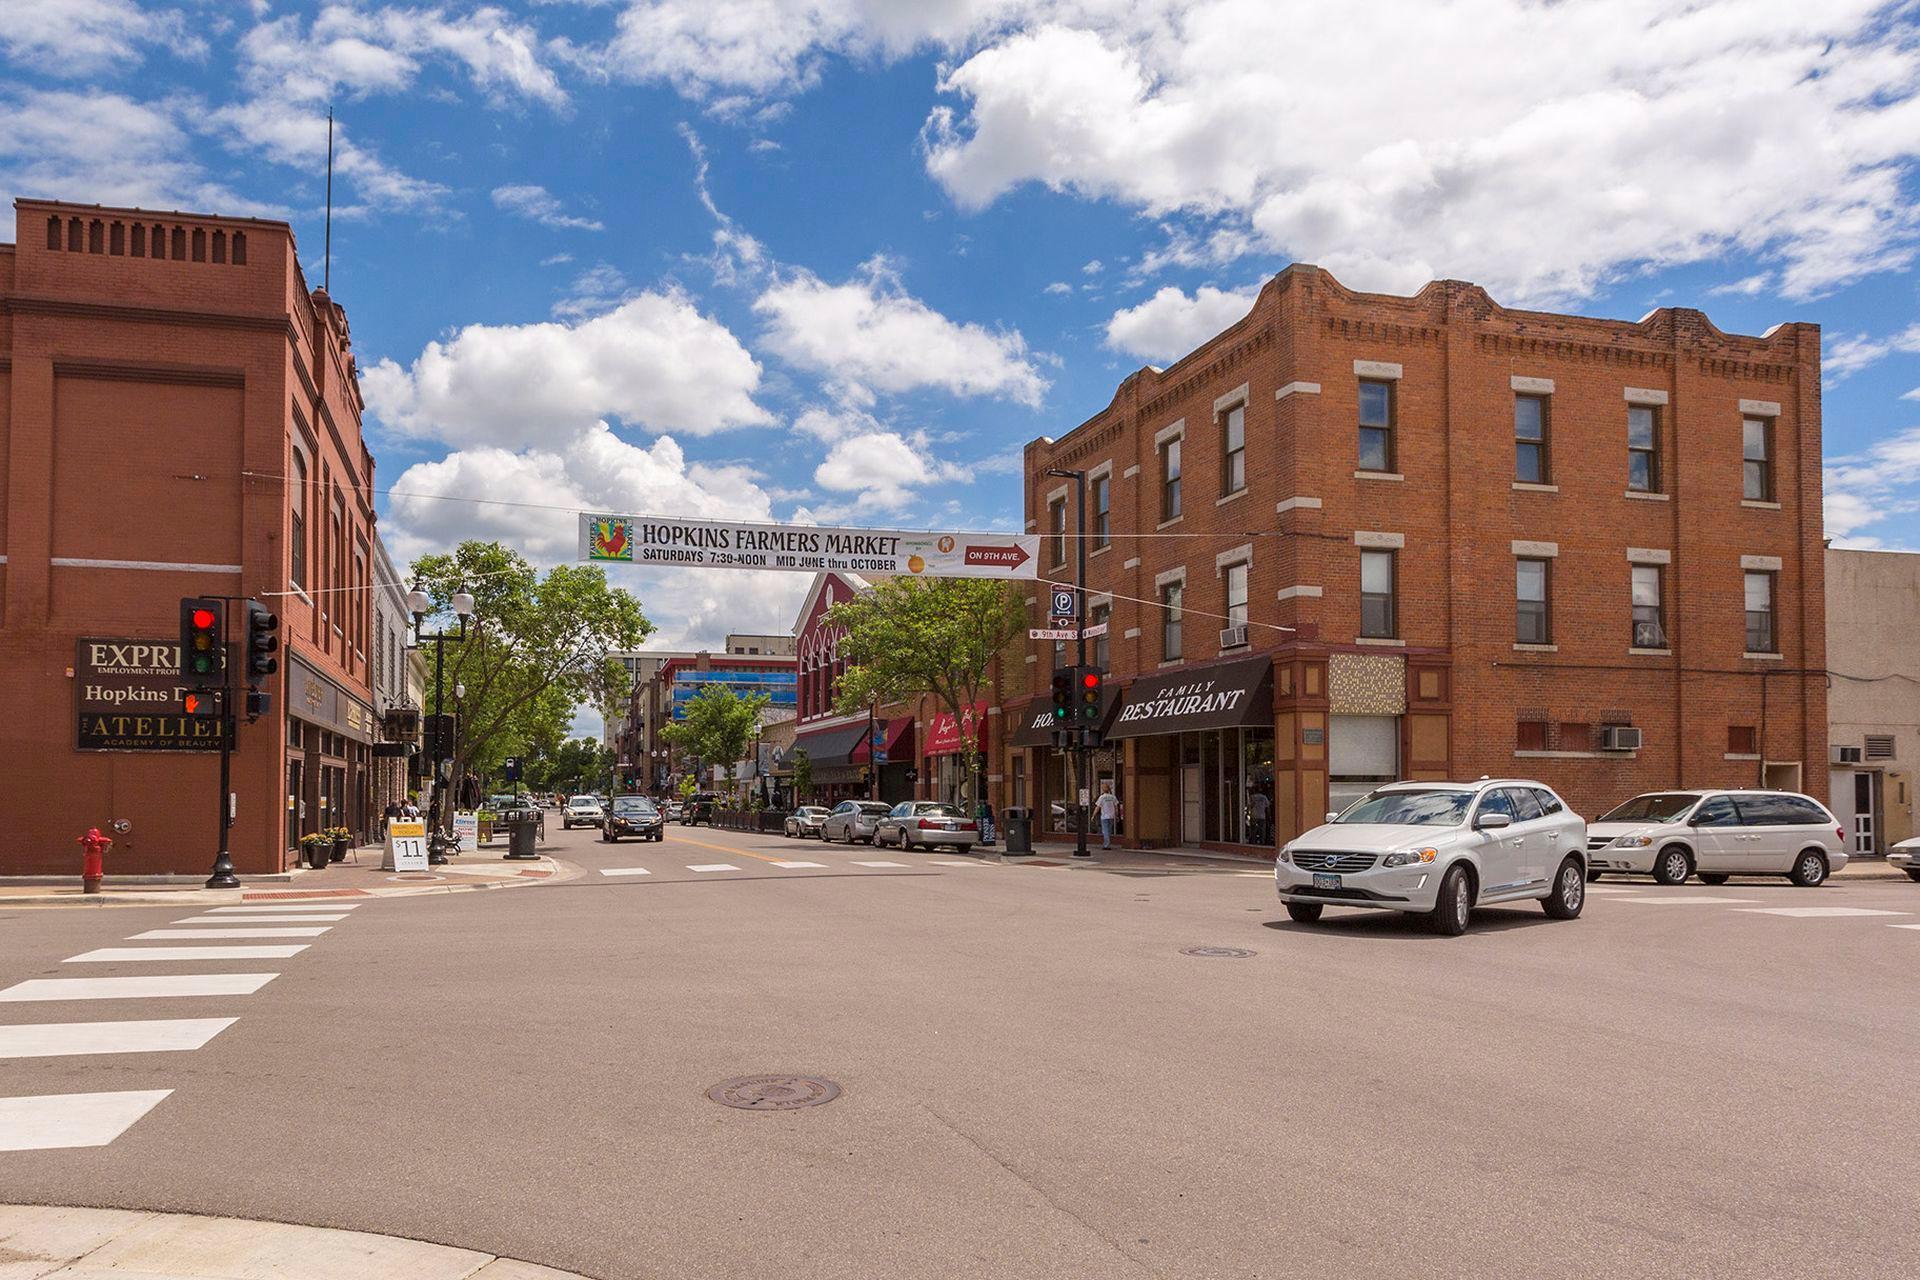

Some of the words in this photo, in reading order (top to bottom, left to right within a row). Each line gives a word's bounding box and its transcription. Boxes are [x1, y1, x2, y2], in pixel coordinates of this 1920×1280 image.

[643, 524, 729, 548] HOPKINS
[736, 530, 820, 553] FARMERS
[825, 534, 900, 556] MARKET
[643, 548, 704, 563] SATURDAYS
[710, 552, 766, 566] 7:30-NOON
[776, 555, 796, 567] MID
[799, 556, 825, 568] JUNE
[828, 557, 848, 569] thru
[851, 558, 896, 571] OCTOBER
[969, 552, 982, 560] ON
[984, 552, 1000, 560] 9TH
[1001, 553, 1020, 561] AVE.
[97, 667, 154, 675] EMPLOYMENT
[85, 685, 168, 705] Hopkins
[1157, 680, 1215, 699] FAMILY
[1119, 689, 1246, 722] RESTAURANT
[396, 840, 423, 858] $11
